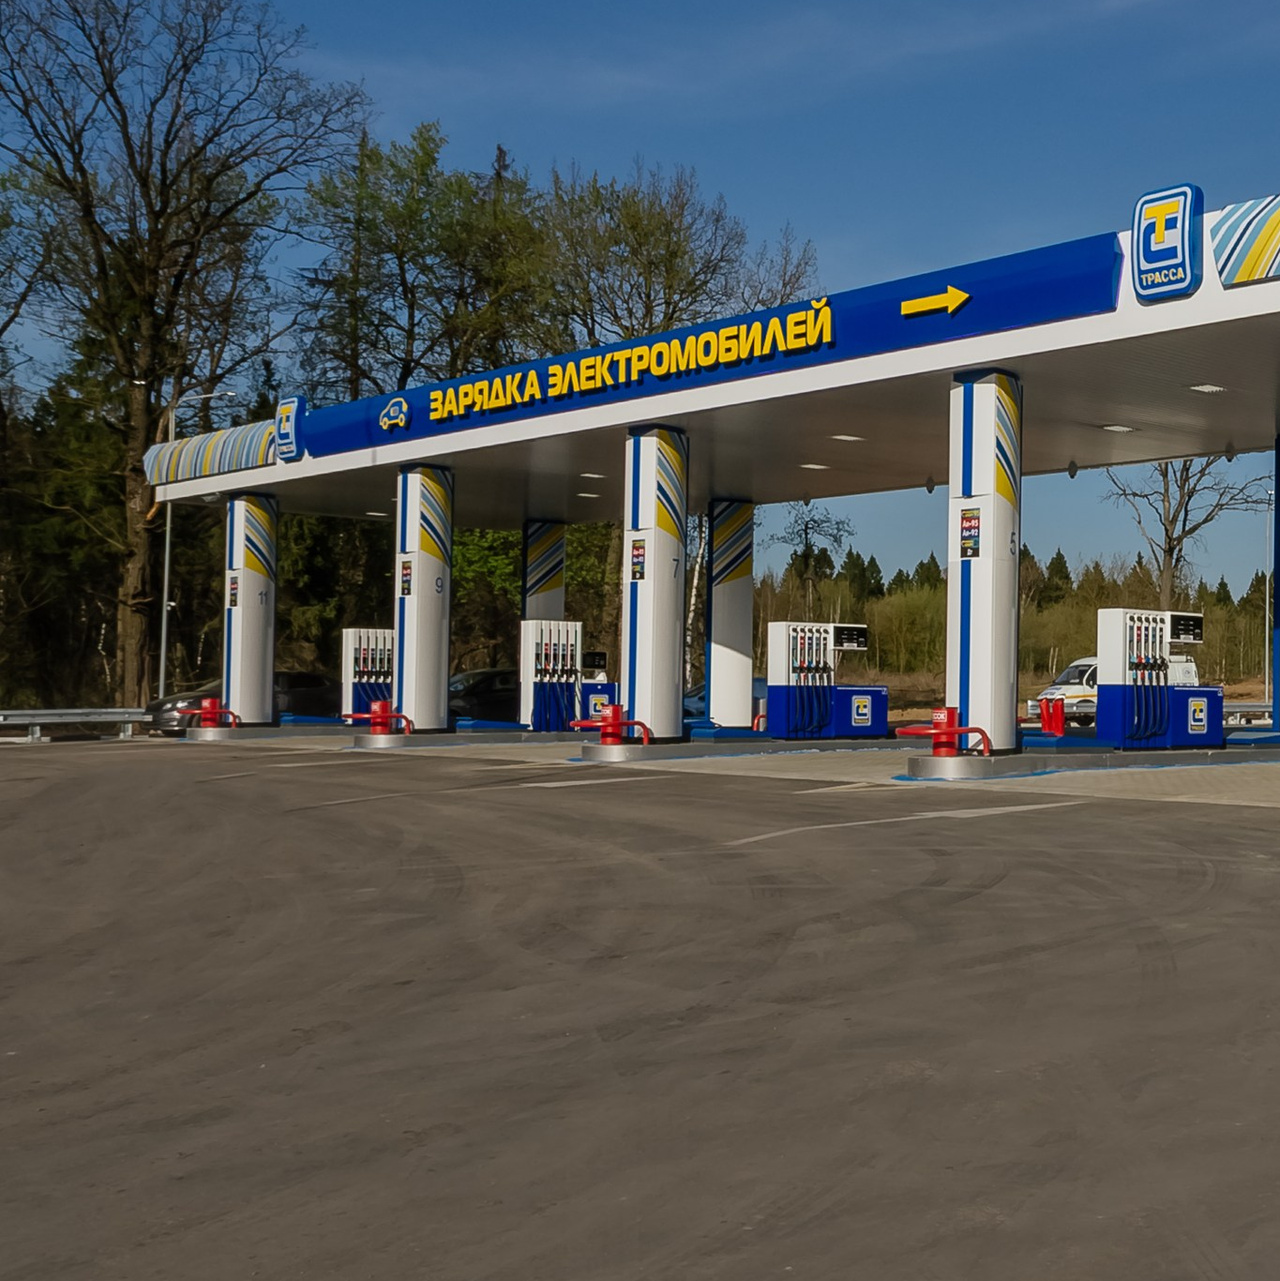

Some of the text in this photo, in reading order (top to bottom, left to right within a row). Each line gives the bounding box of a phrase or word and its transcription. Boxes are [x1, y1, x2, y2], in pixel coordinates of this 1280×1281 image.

[1140, 267, 1185, 286] ТРАССА
[429, 297, 833, 421] ЗАРЯДКА ЭЛЕКТРОМОБИЛЕЙ
[672, 558, 680, 579] 7
[435, 577, 443, 594] 9
